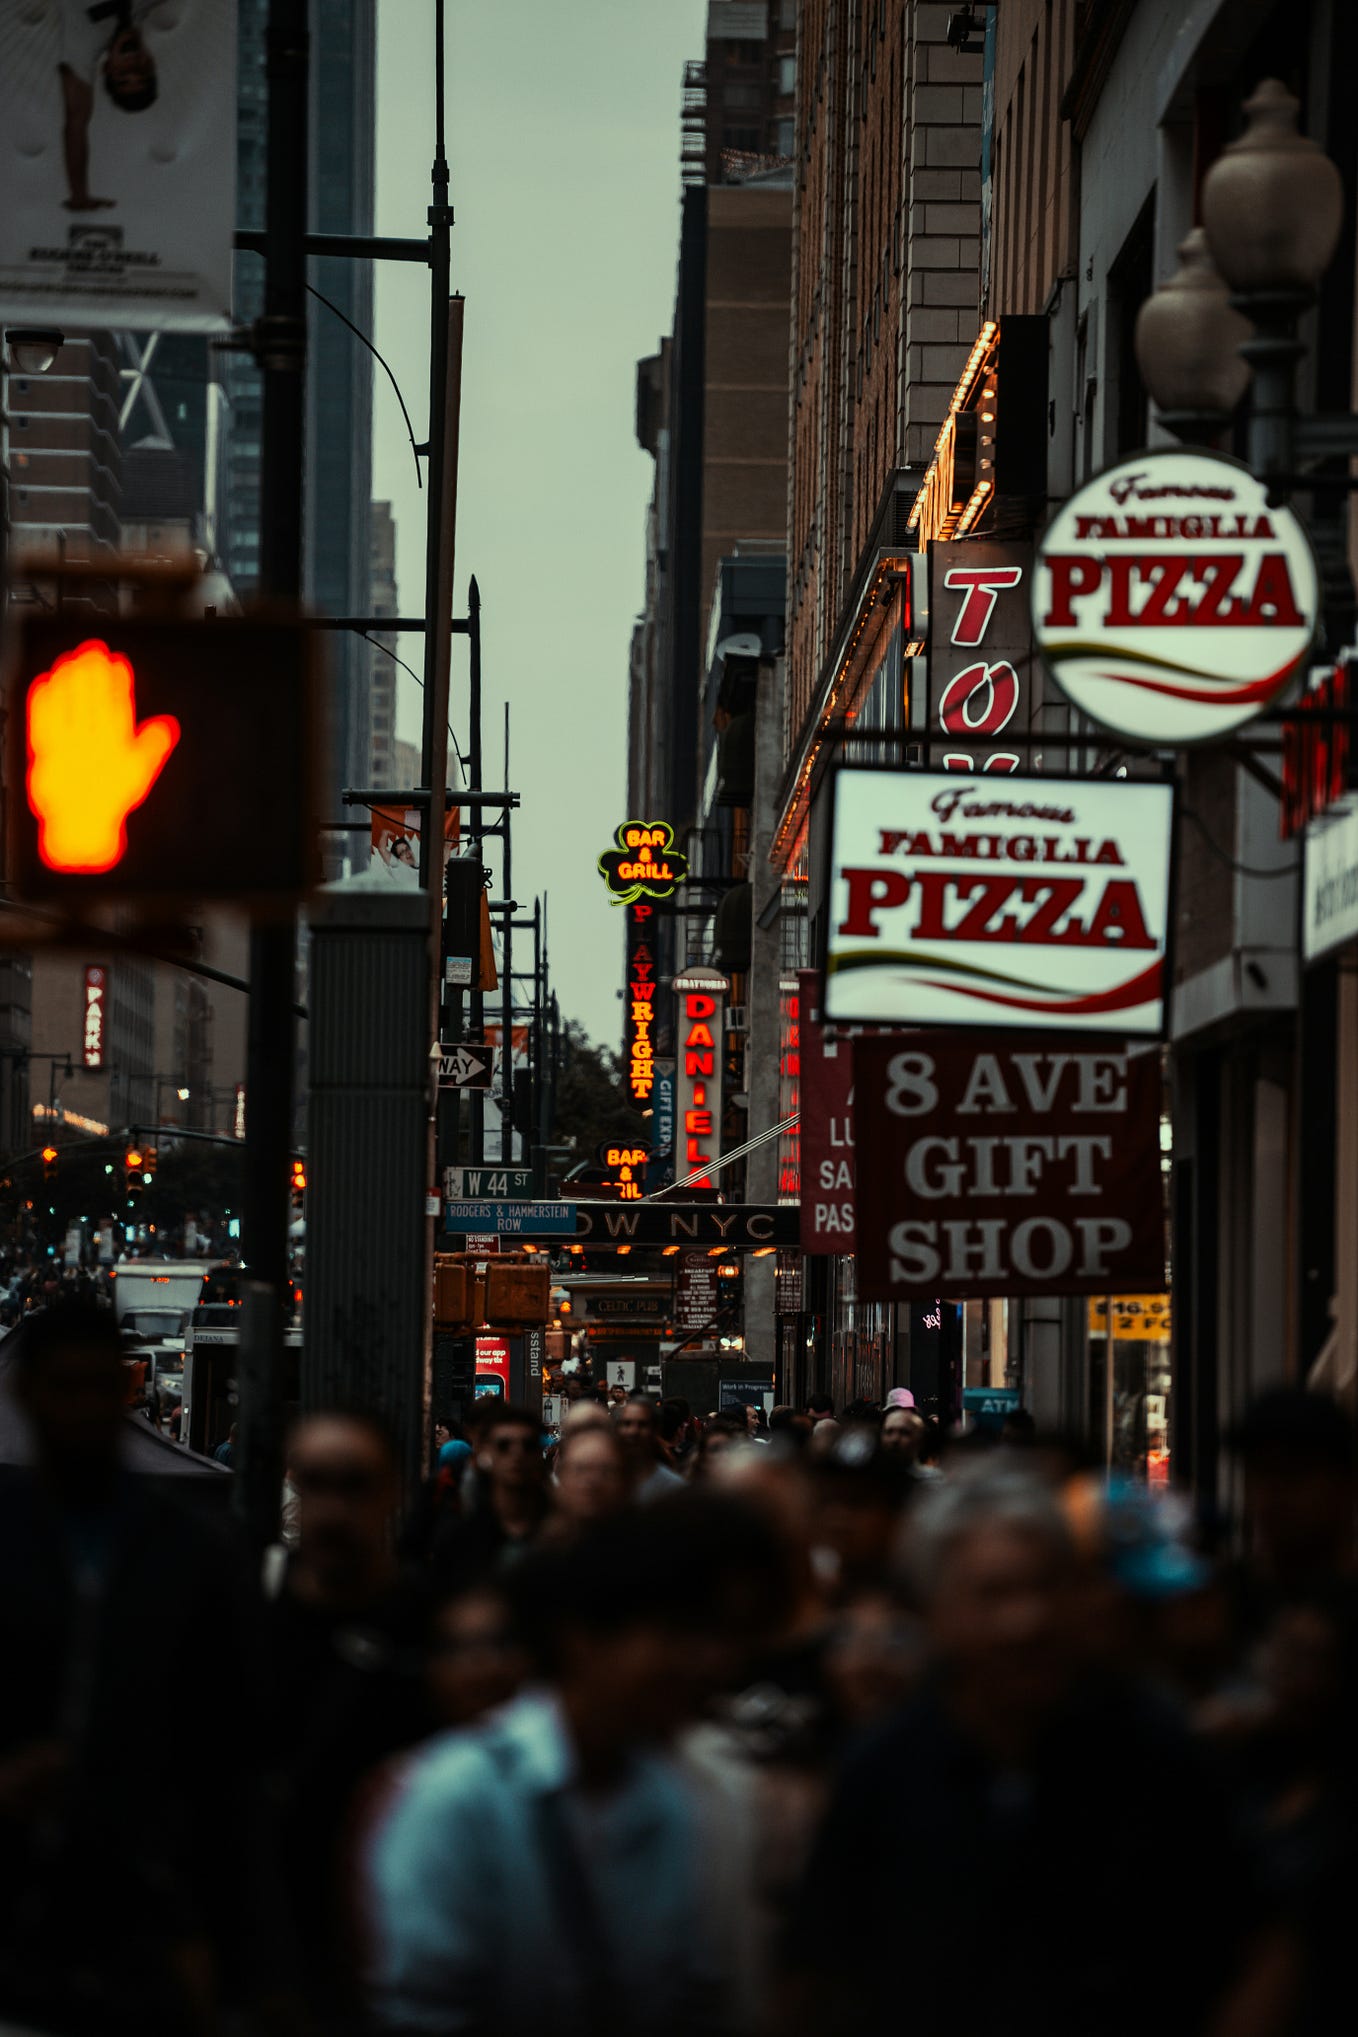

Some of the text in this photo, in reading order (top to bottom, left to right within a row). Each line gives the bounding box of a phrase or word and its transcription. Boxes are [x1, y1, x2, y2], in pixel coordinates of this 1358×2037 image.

[1109, 472, 1237, 505] Famous
[1074, 514, 1277, 540] FAMIGLIA
[1043, 554, 1307, 628] PIZZA
[929, 786, 1077, 825] Famous
[626, 829, 666, 847] BAR
[876, 829, 1126, 866] FAMIGLIA
[638, 846, 652, 863] &
[617, 861, 674, 880] GRILL
[838, 867, 1158, 950] PIZZA
[439, 1056, 474, 1075] WAY
[659, 1079, 673, 1113] GIFT
[685, 993, 716, 1188] DANIELA
[885, 1051, 1129, 1117] 8 AVE
[904, 1135, 1113, 1199] GIFT
[467, 1172, 528, 1196] W 44 ST
[450, 1204, 491, 1218] RODGERS
[496, 1205, 504, 1218] &
[508, 1205, 569, 1218] HAMMERSTEIN
[497, 1218, 522, 1232] ROW
[670, 1212, 776, 1240] NYC
[888, 1216, 1133, 1283] SHOP
[1119, 1317, 1132, 1329] 2
